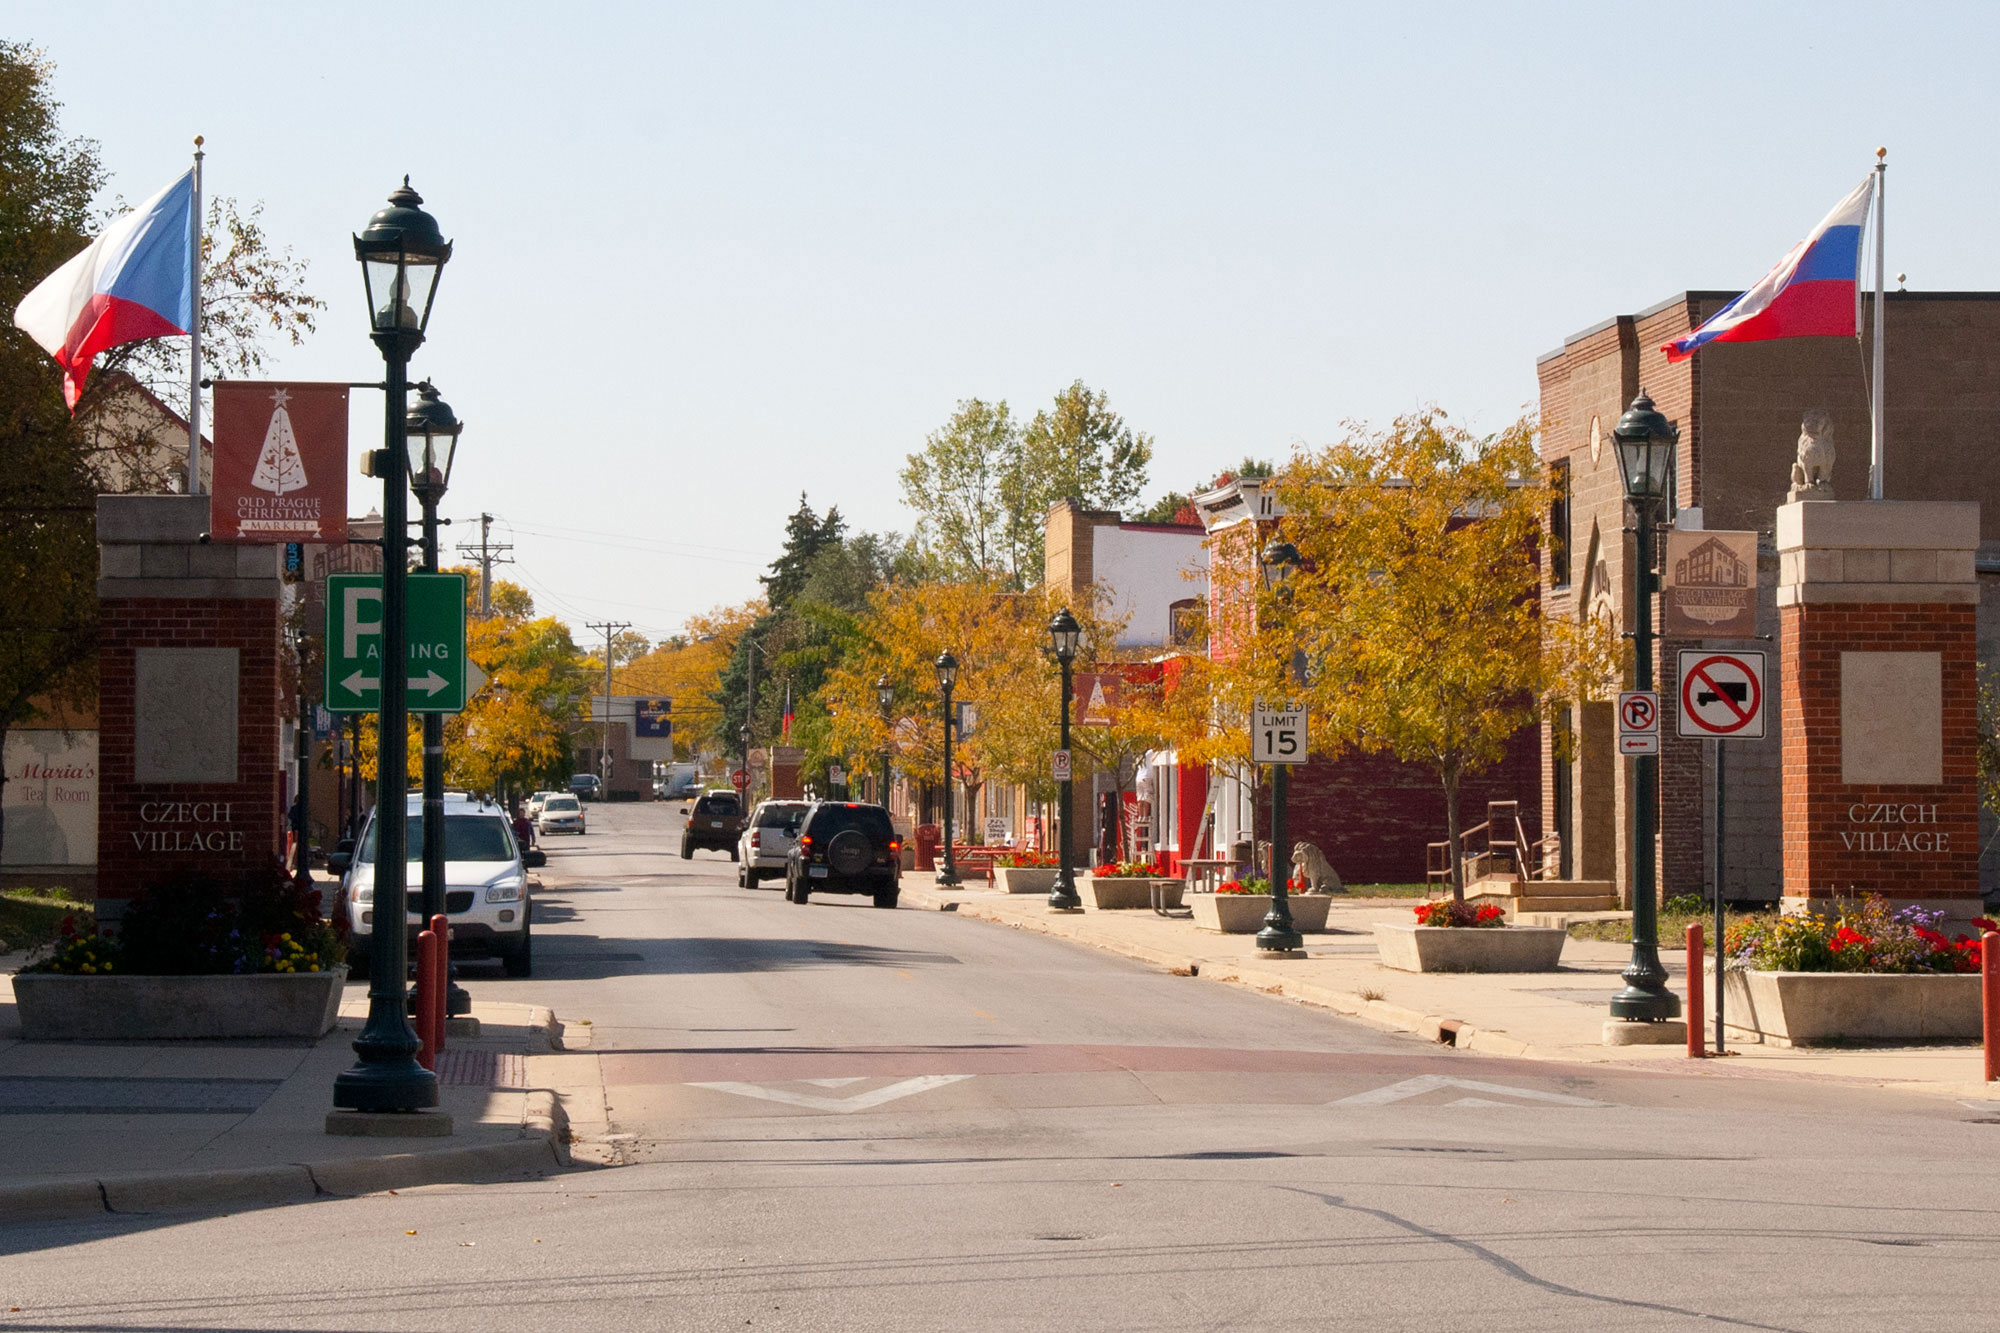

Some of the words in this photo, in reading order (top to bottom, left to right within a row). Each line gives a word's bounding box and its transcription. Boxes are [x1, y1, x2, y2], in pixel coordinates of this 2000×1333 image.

[237, 496, 266, 508] OLD
[270, 497, 321, 508] PRAGUE
[236, 508, 321, 519] CHRISTMAS
[251, 521, 308, 530] MARKET
[1675, 589, 1703, 597] CZECH
[1706, 590, 1747, 598] VILLAGE
[1701, 597, 1747, 606] BOHEMIA
[343, 587, 449, 659] PAING
[1257, 702, 1304, 713] SPED
[1262, 716, 1298, 727] LIMIT
[1264, 730, 1298, 755] 15
[14, 763, 95, 779] Maria's
[23, 786, 44, 801] Tea
[55, 787, 91, 802] Room
[140, 801, 232, 823] CZECH
[1848, 803, 1938, 824] CZECH
[130, 830, 244, 852] VILLAGE
[1839, 831, 1951, 853] VILLAGE
